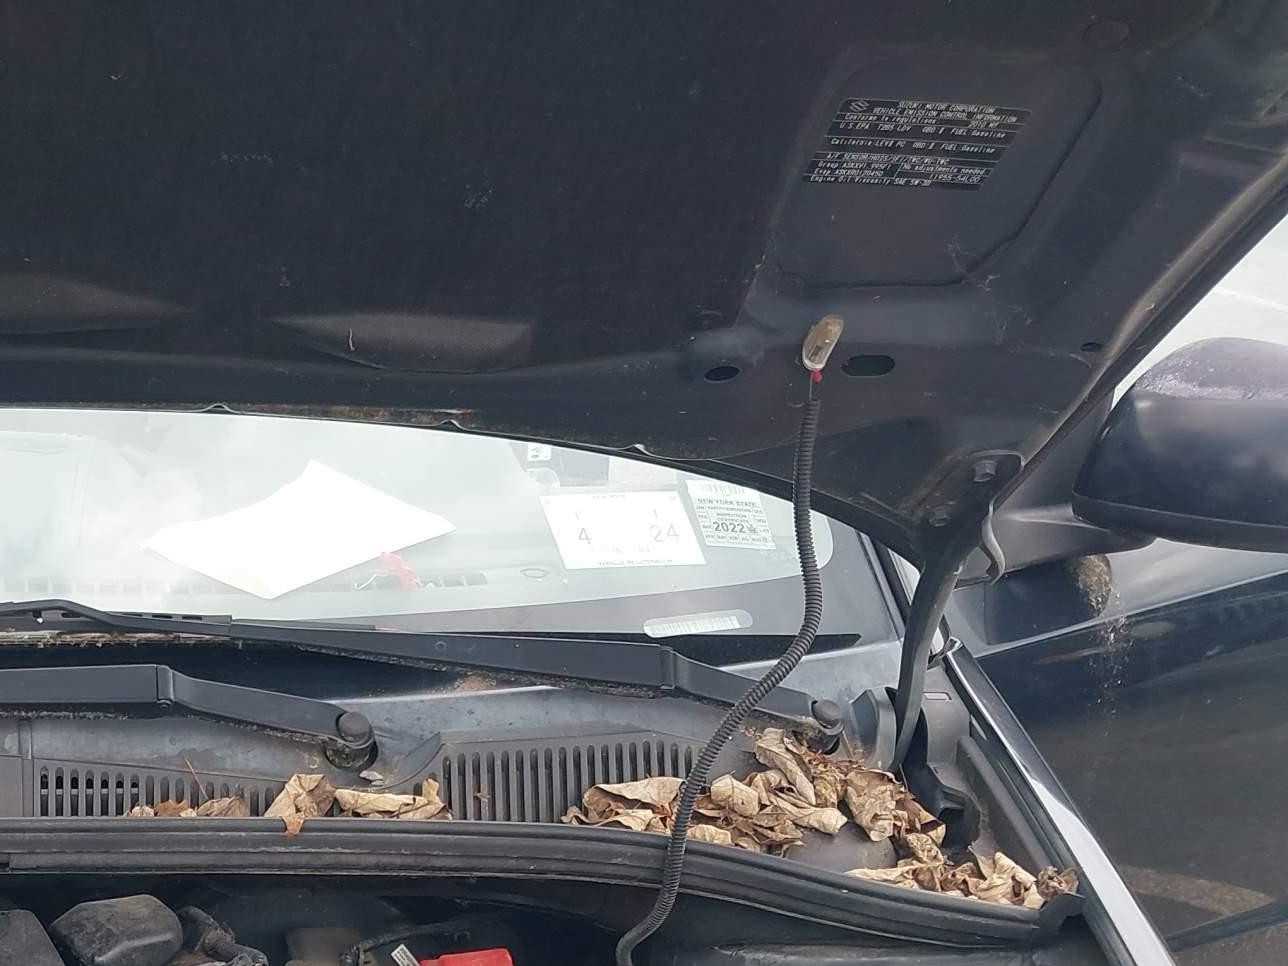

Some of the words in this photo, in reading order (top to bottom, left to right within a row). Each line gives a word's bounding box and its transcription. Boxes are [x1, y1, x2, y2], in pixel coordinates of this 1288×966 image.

[578, 526, 593, 545] 4
[649, 523, 680, 544] 24
[712, 521, 747, 534] 2022
